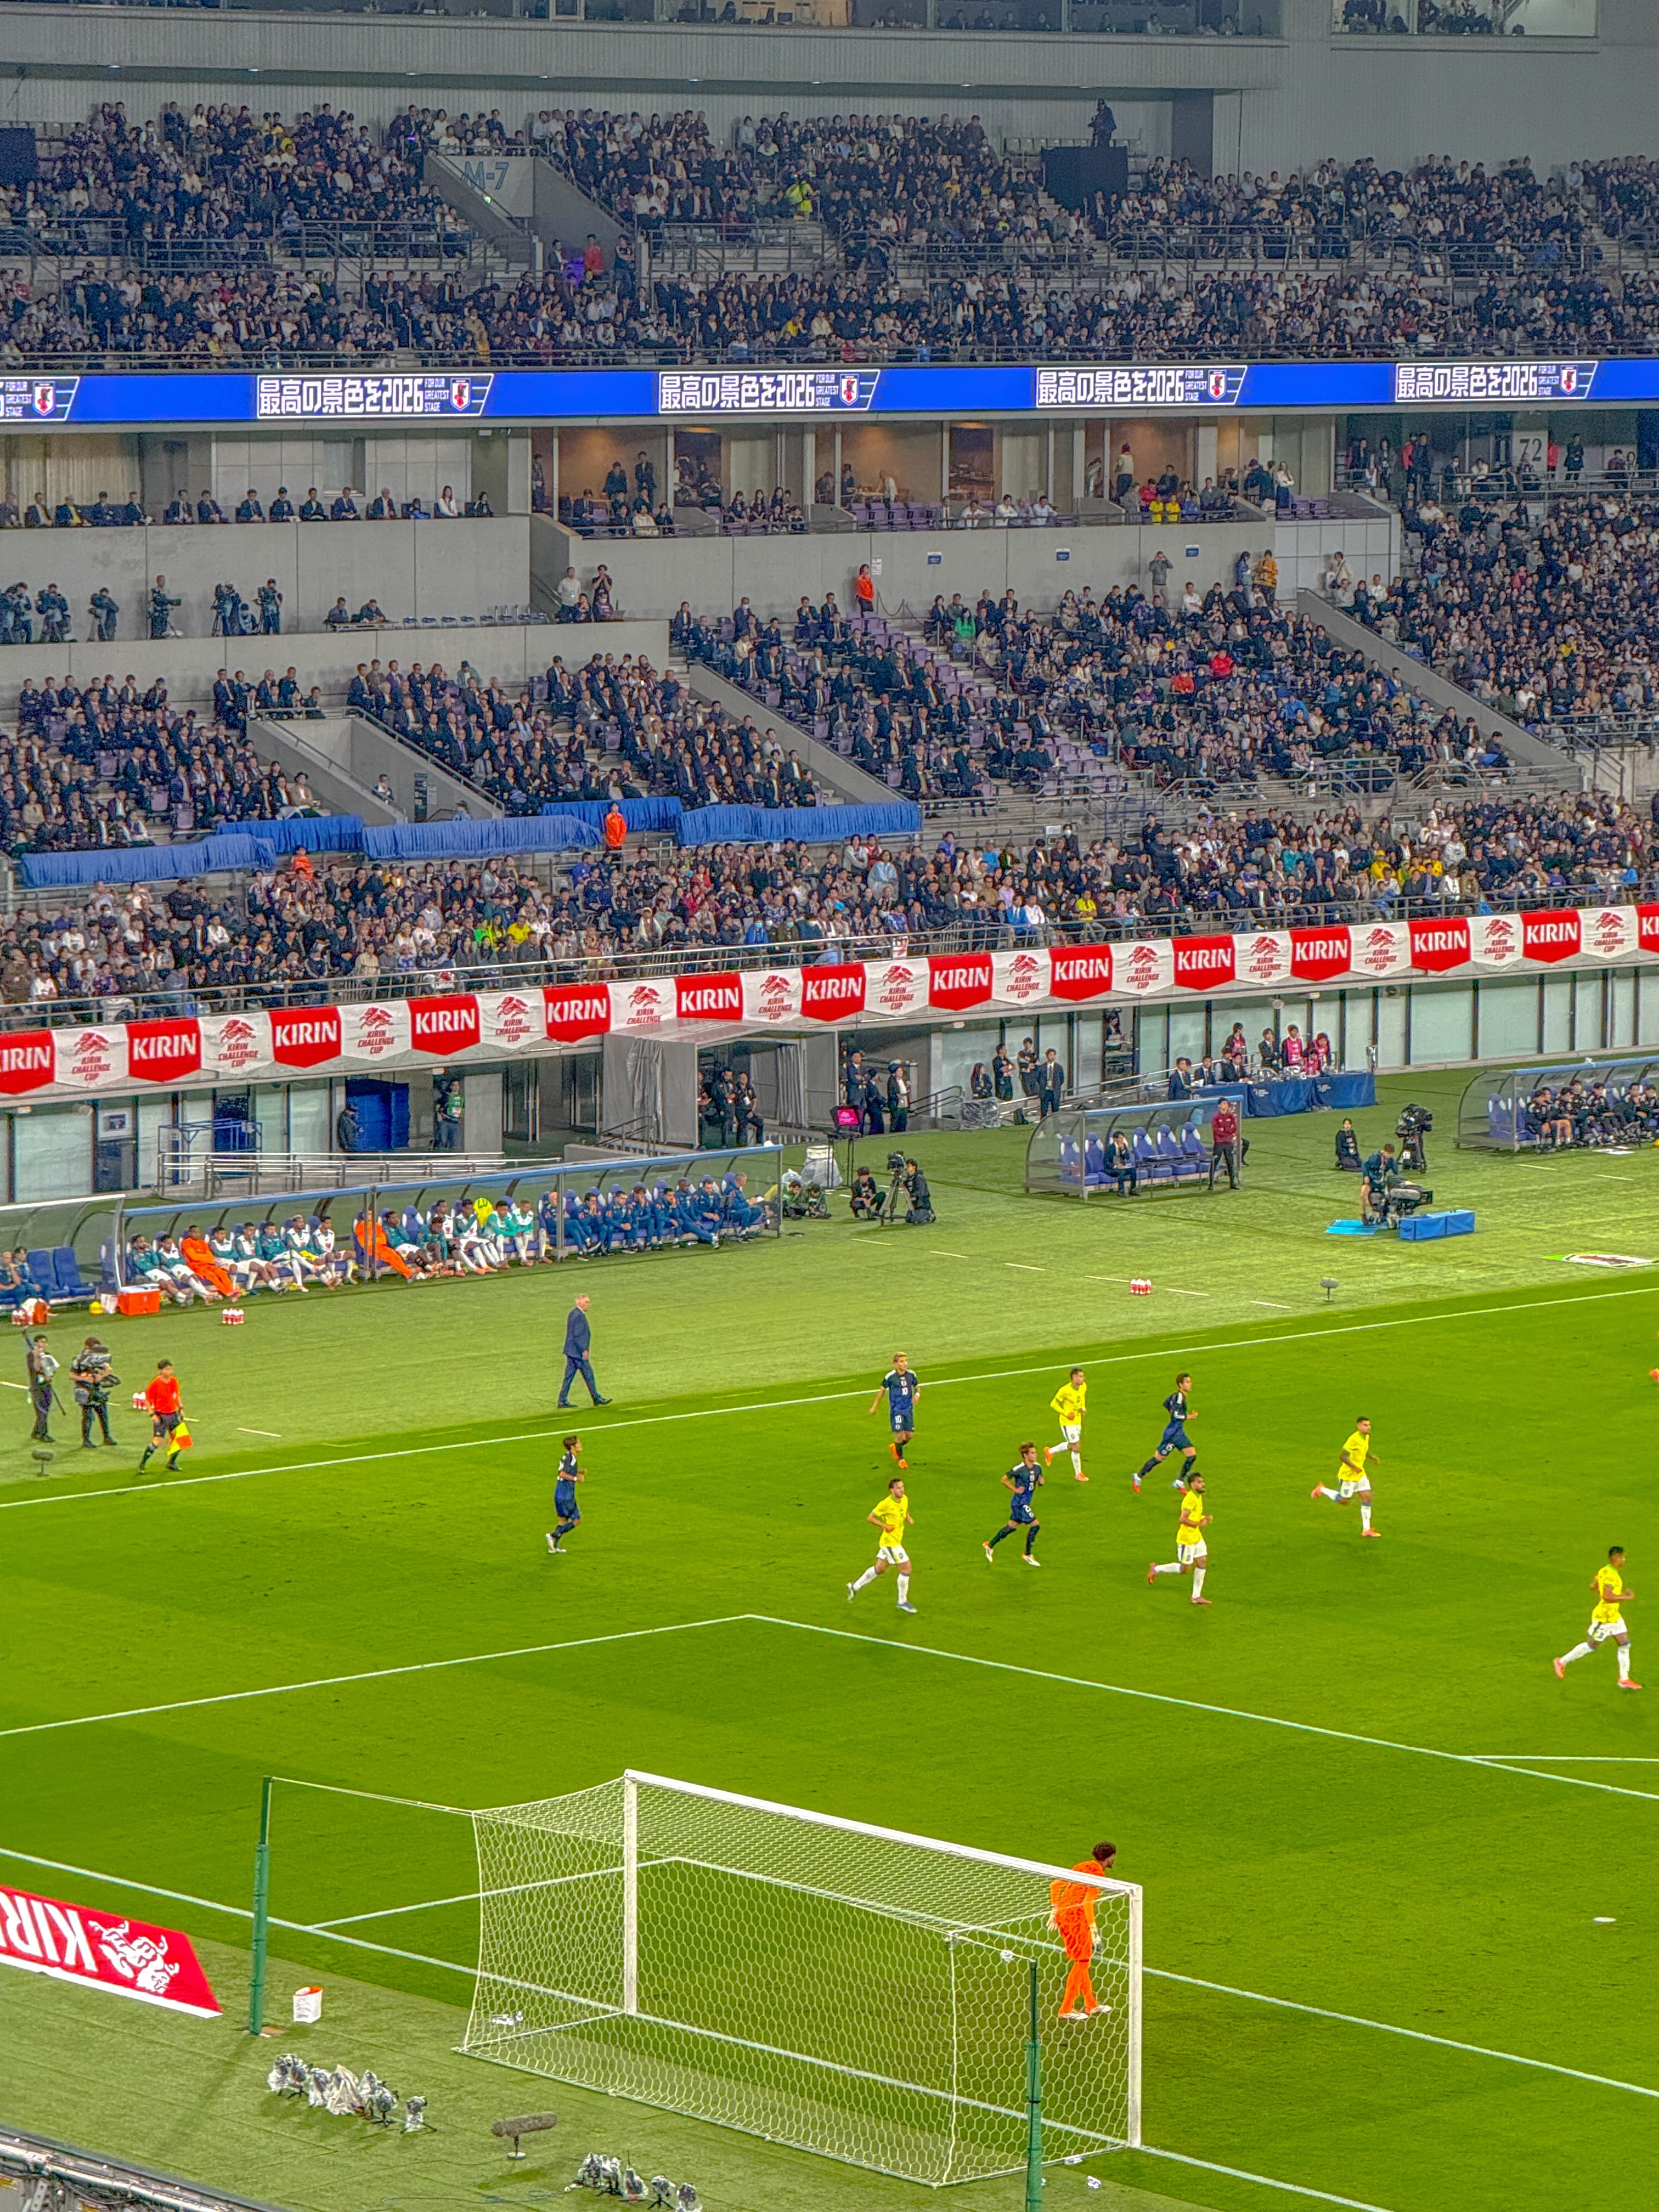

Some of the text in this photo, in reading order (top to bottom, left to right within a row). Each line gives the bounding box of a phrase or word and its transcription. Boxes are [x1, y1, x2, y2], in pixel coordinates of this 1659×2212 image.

[462, 161, 509, 190] M-7
[1398, 365, 1537, 397] 最高の景色を2026
[1039, 370, 1184, 403] 最高の景色を2026
[259, 379, 424, 414] 最高の景色を2026
[662, 375, 815, 409] 最高の景色を2026
[1519, 438, 1542, 461] 72
[1527, 922, 1577, 944] KIRIN
[1414, 930, 1466, 952] KIRIN
[1594, 938, 1624, 947] CHALLENGE
[1296, 939, 1347, 961] KIRIN
[1484, 945, 1515, 955] CHALLENGE
[1178, 948, 1231, 970] KIRIN
[1365, 955, 1397, 964] CHALLENGE
[1494, 952, 1506, 961] CUP
[1055, 958, 1109, 980] KIRIN
[1249, 963, 1281, 973] CHALLENGE
[934, 967, 990, 991] KIRIN
[1127, 973, 1159, 983] CHALLENGE
[1260, 970, 1272, 979] CUP
[806, 977, 864, 1002] KIRIN
[1006, 981, 1039, 992] CHALLENGE
[1137, 981, 1149, 989] CUP
[880, 994, 913, 1003] CHALLENGE
[1017, 990, 1030, 998] CUP
[681, 988, 738, 1012] KIRIN
[548, 998, 606, 1023] KIRIN
[758, 1003, 792, 1013] CHALLENGE
[627, 1014, 661, 1024] CHALLENGE
[769, 1012, 782, 1020] CUP
[416, 1009, 475, 1034] KIRIN
[275, 1021, 336, 1046] KIRIN
[367, 1029, 386, 1037] KIRIN
[495, 1025, 529, 1034] CHALLENGE
[358, 1036, 394, 1047] CHALLENGE
[507, 1034, 521, 1042] CUP
[134, 1034, 196, 1059] KIRIN
[228, 1042, 247, 1051] KIRIN
[370, 1045, 383, 1054] CUP
[0, 1046, 50, 1072] IRIN
[219, 1050, 258, 1060] CHALLENGE
[72, 1063, 110, 1073] CHALLENGE
[232, 1058, 246, 1068] CUP
[84, 1072, 99, 1081] CUP
[901, 1387, 908, 1396] 10
[895, 1415, 902, 1424] 10
[0, 1892, 98, 1971] KIR
